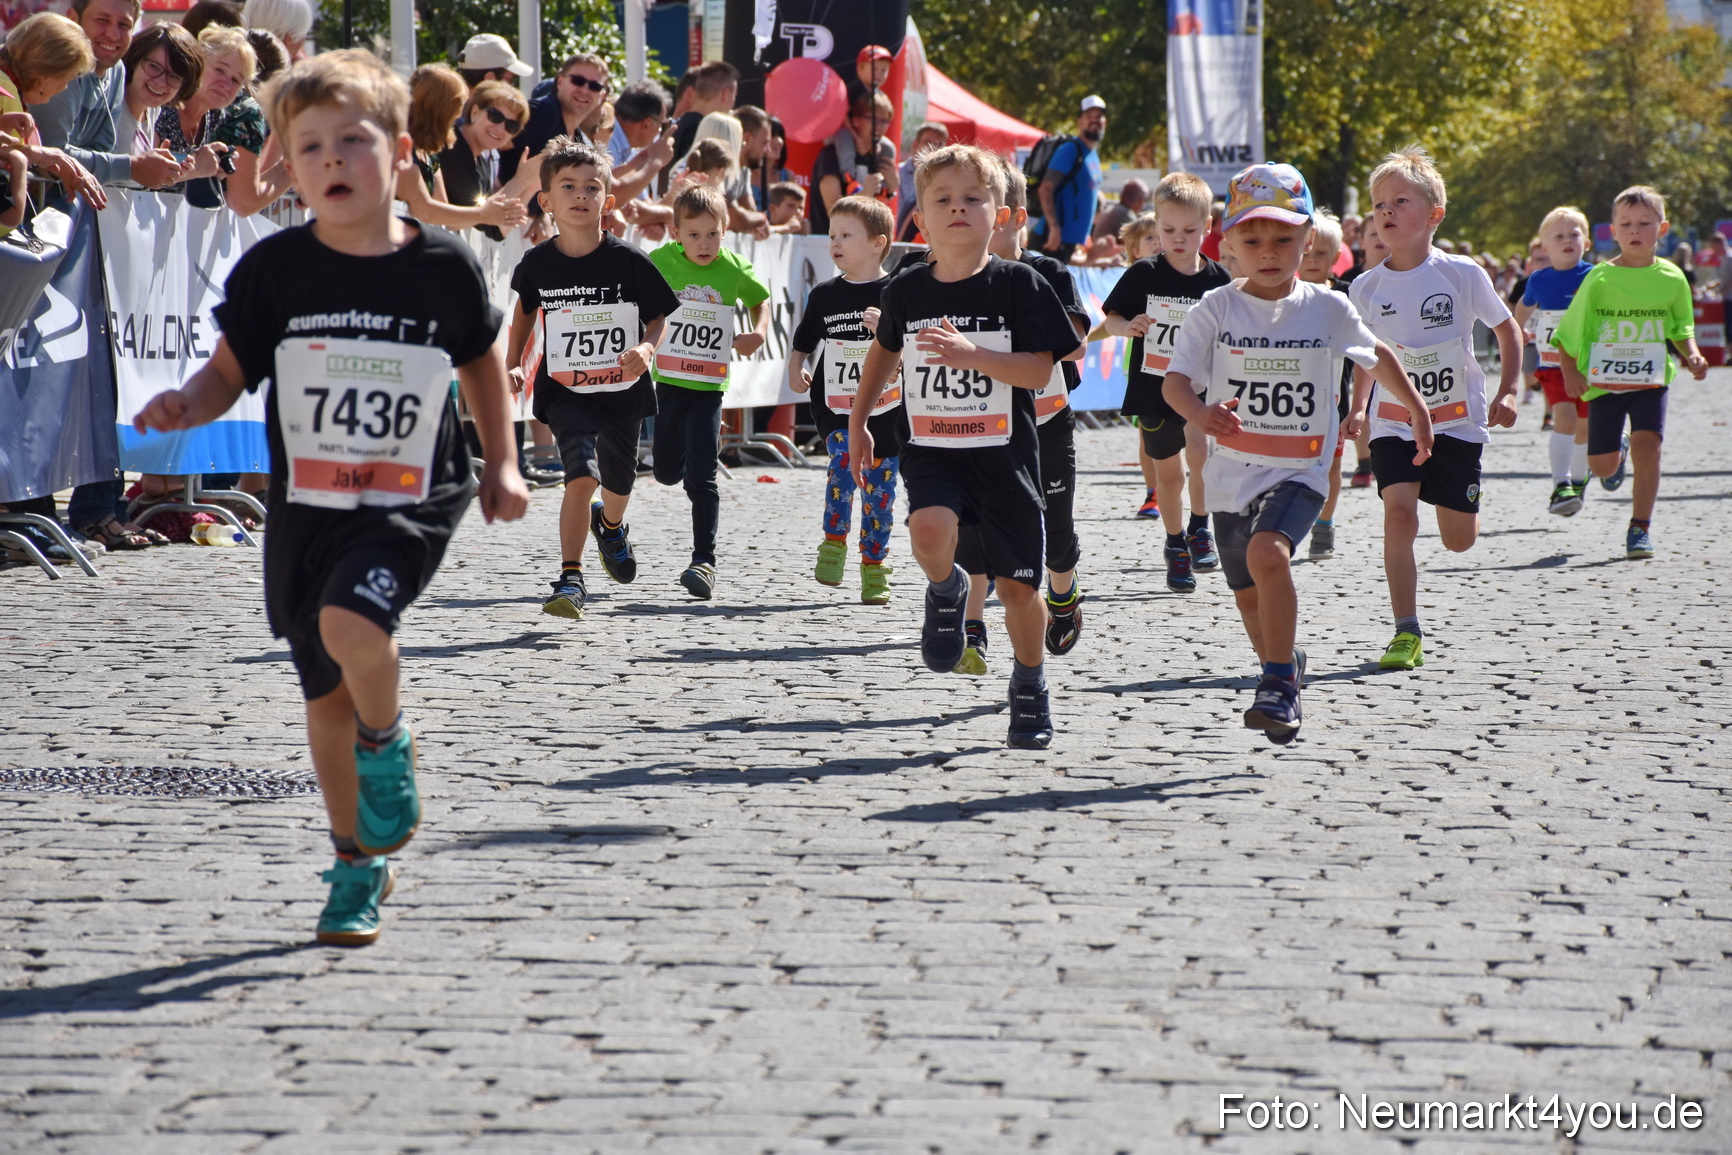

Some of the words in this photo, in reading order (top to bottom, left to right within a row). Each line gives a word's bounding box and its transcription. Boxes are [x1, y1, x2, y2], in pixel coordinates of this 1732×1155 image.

[288, 309, 393, 332] eumarkter
[573, 312, 613, 324] BOCK
[682, 307, 717, 320] BOCK
[1596, 309, 1615, 318] TEAM
[561, 327, 626, 358] 7579
[669, 321, 724, 351] 7092
[589, 358, 615, 366] Neumarkt
[688, 351, 711, 359] Neumarkt
[1404, 352, 1439, 366] BOCK
[326, 355, 403, 377] BOCK
[681, 360, 704, 373] Leon
[1244, 358, 1300, 372] BOCK
[1601, 360, 1654, 375] 7554
[571, 369, 623, 387] David
[915, 366, 993, 399] 7435
[1228, 378, 1315, 418] 7563
[304, 387, 421, 440] 7436
[926, 404, 943, 412] PARTL
[944, 404, 977, 412] Neumarkt
[929, 419, 986, 435] Johannes
[1260, 422, 1298, 431] Neumarkt
[1046, 486, 1066, 495] erima
[1013, 568, 1034, 578] JAKO
